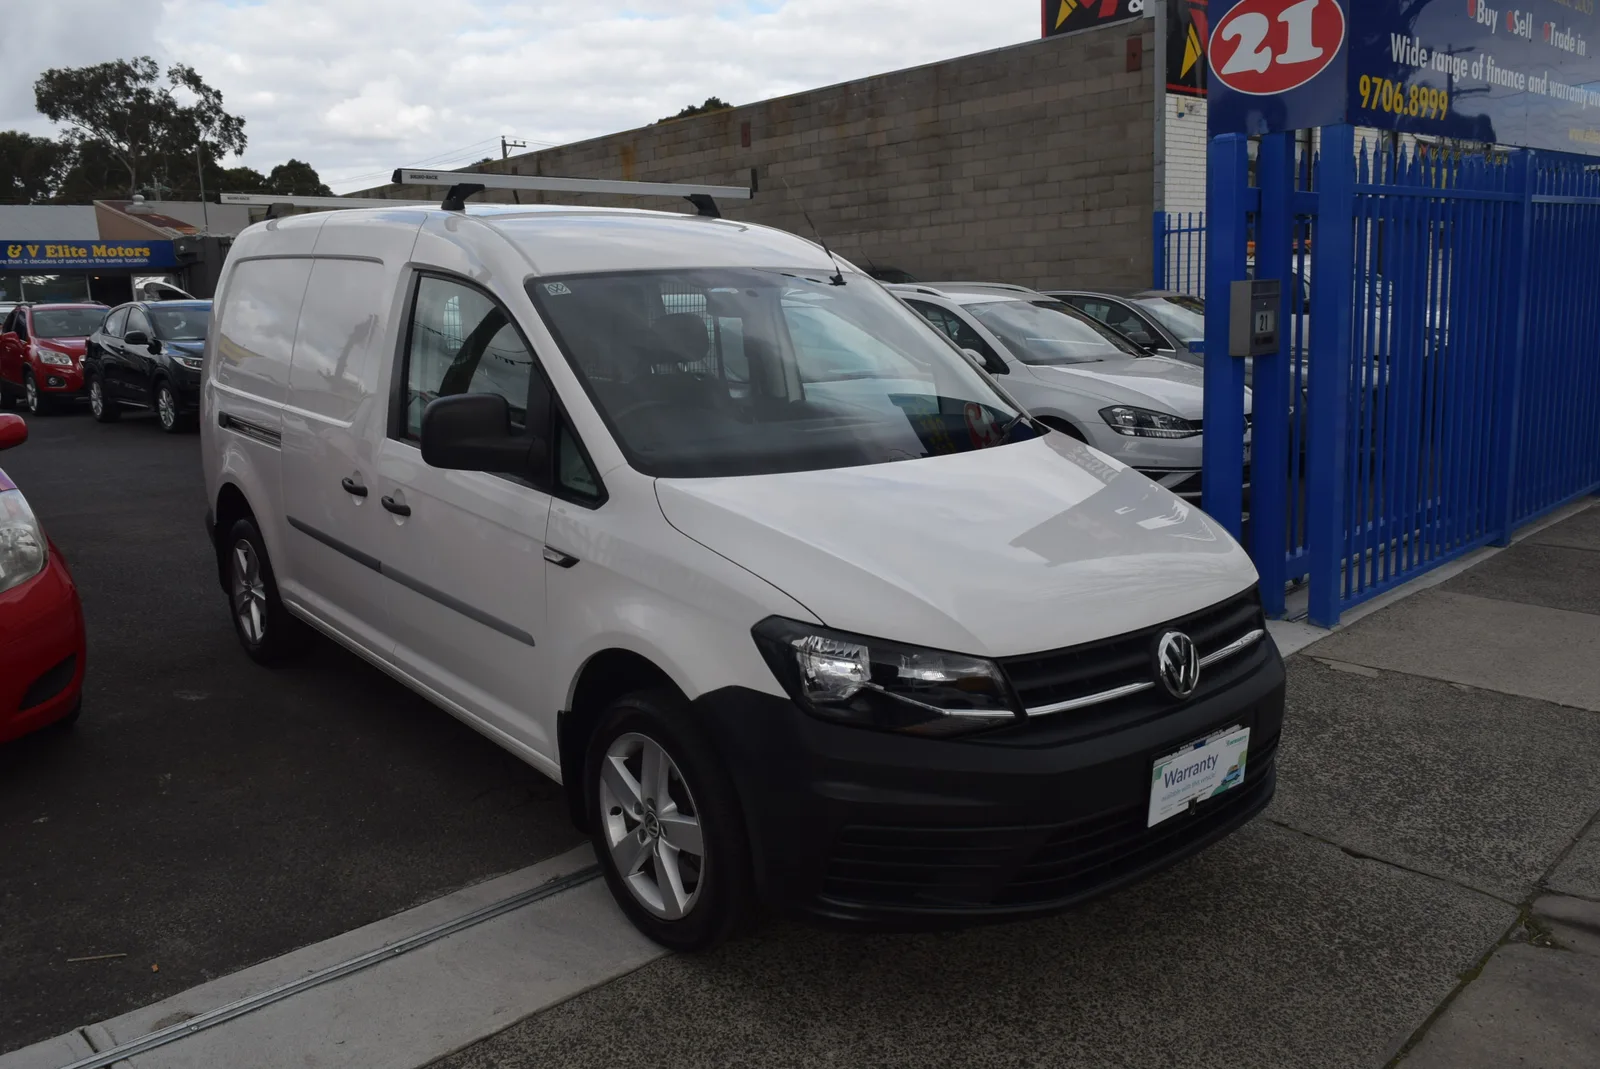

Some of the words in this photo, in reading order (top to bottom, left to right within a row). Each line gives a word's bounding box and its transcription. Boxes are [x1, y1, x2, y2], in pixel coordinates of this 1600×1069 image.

[1221, 0, 1323, 75] 21
[1476, 0, 1498, 34] Buy
[1512, 9, 1533, 39] Sell
[1550, 22, 1575, 53] Trade
[1577, 34, 1586, 56] in
[1390, 32, 1428, 68] Wide
[1431, 51, 1468, 83] range
[1471, 53, 1484, 81] of
[1486, 55, 1525, 90] finance
[1528, 70, 1548, 96] and
[1549, 80, 1588, 110] warranty
[1359, 74, 1448, 121] 9706.8999
[7, 244, 23, 258] &
[25, 244, 40, 258] V
[44, 244, 88, 258] Elite
[91, 244, 151, 258] Motors
[1260, 314, 1268, 332] 21
[1164, 754, 1219, 788] Warranty
